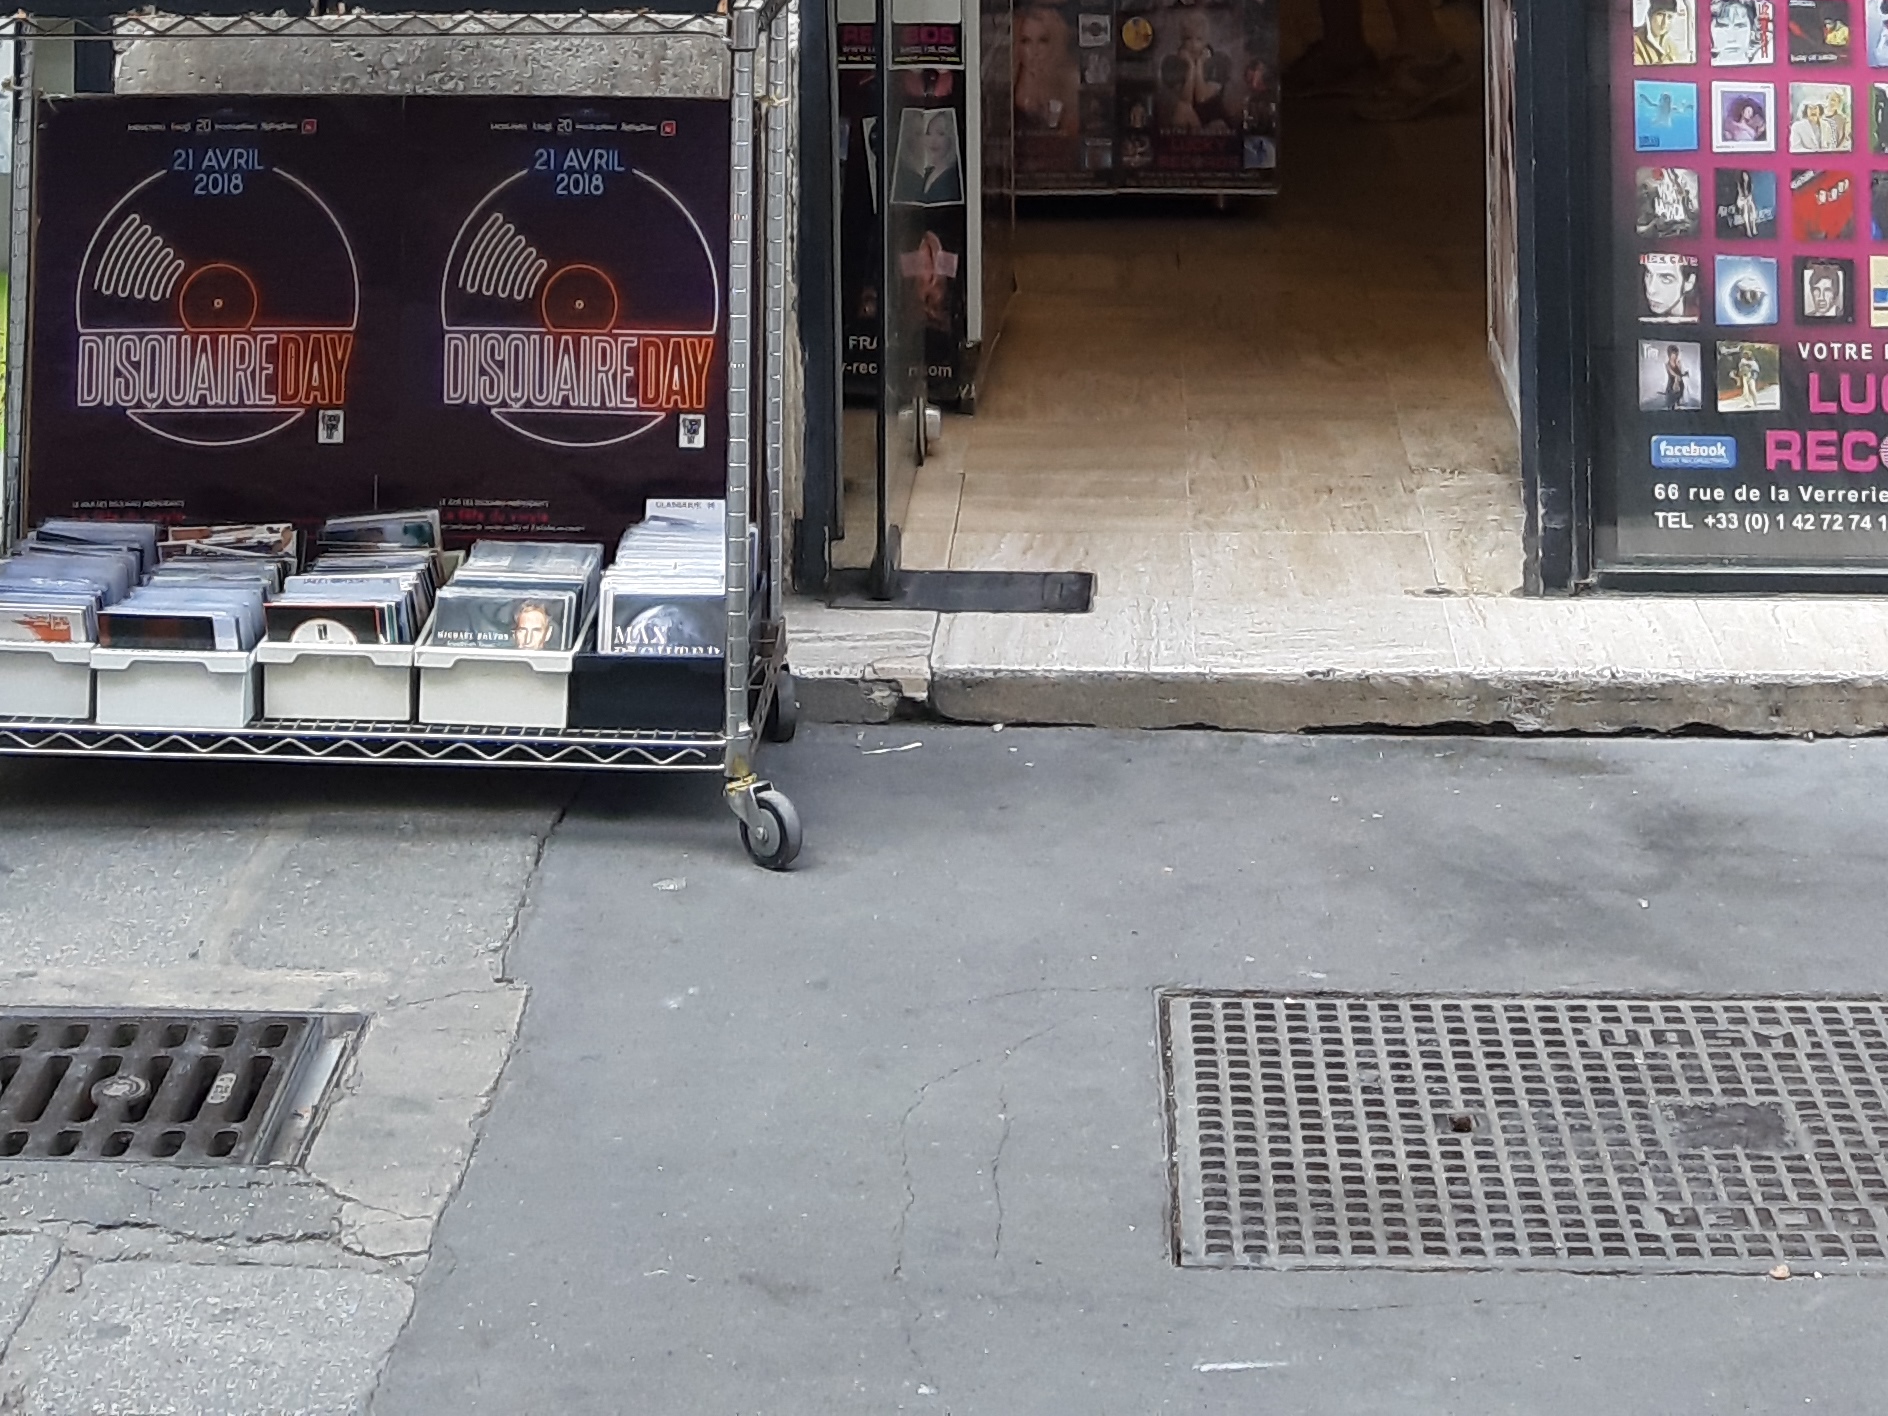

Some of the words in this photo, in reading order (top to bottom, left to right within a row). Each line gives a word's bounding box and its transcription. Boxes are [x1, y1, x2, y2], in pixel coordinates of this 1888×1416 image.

[173, 149, 195, 170] 21
[203, 149, 264, 170] AVRIL
[194, 173, 243, 196] 2018
[1798, 342, 1872, 360] VOTRE
[1660, 441, 1726, 459] facebook
[614, 625, 669, 645] MAX
